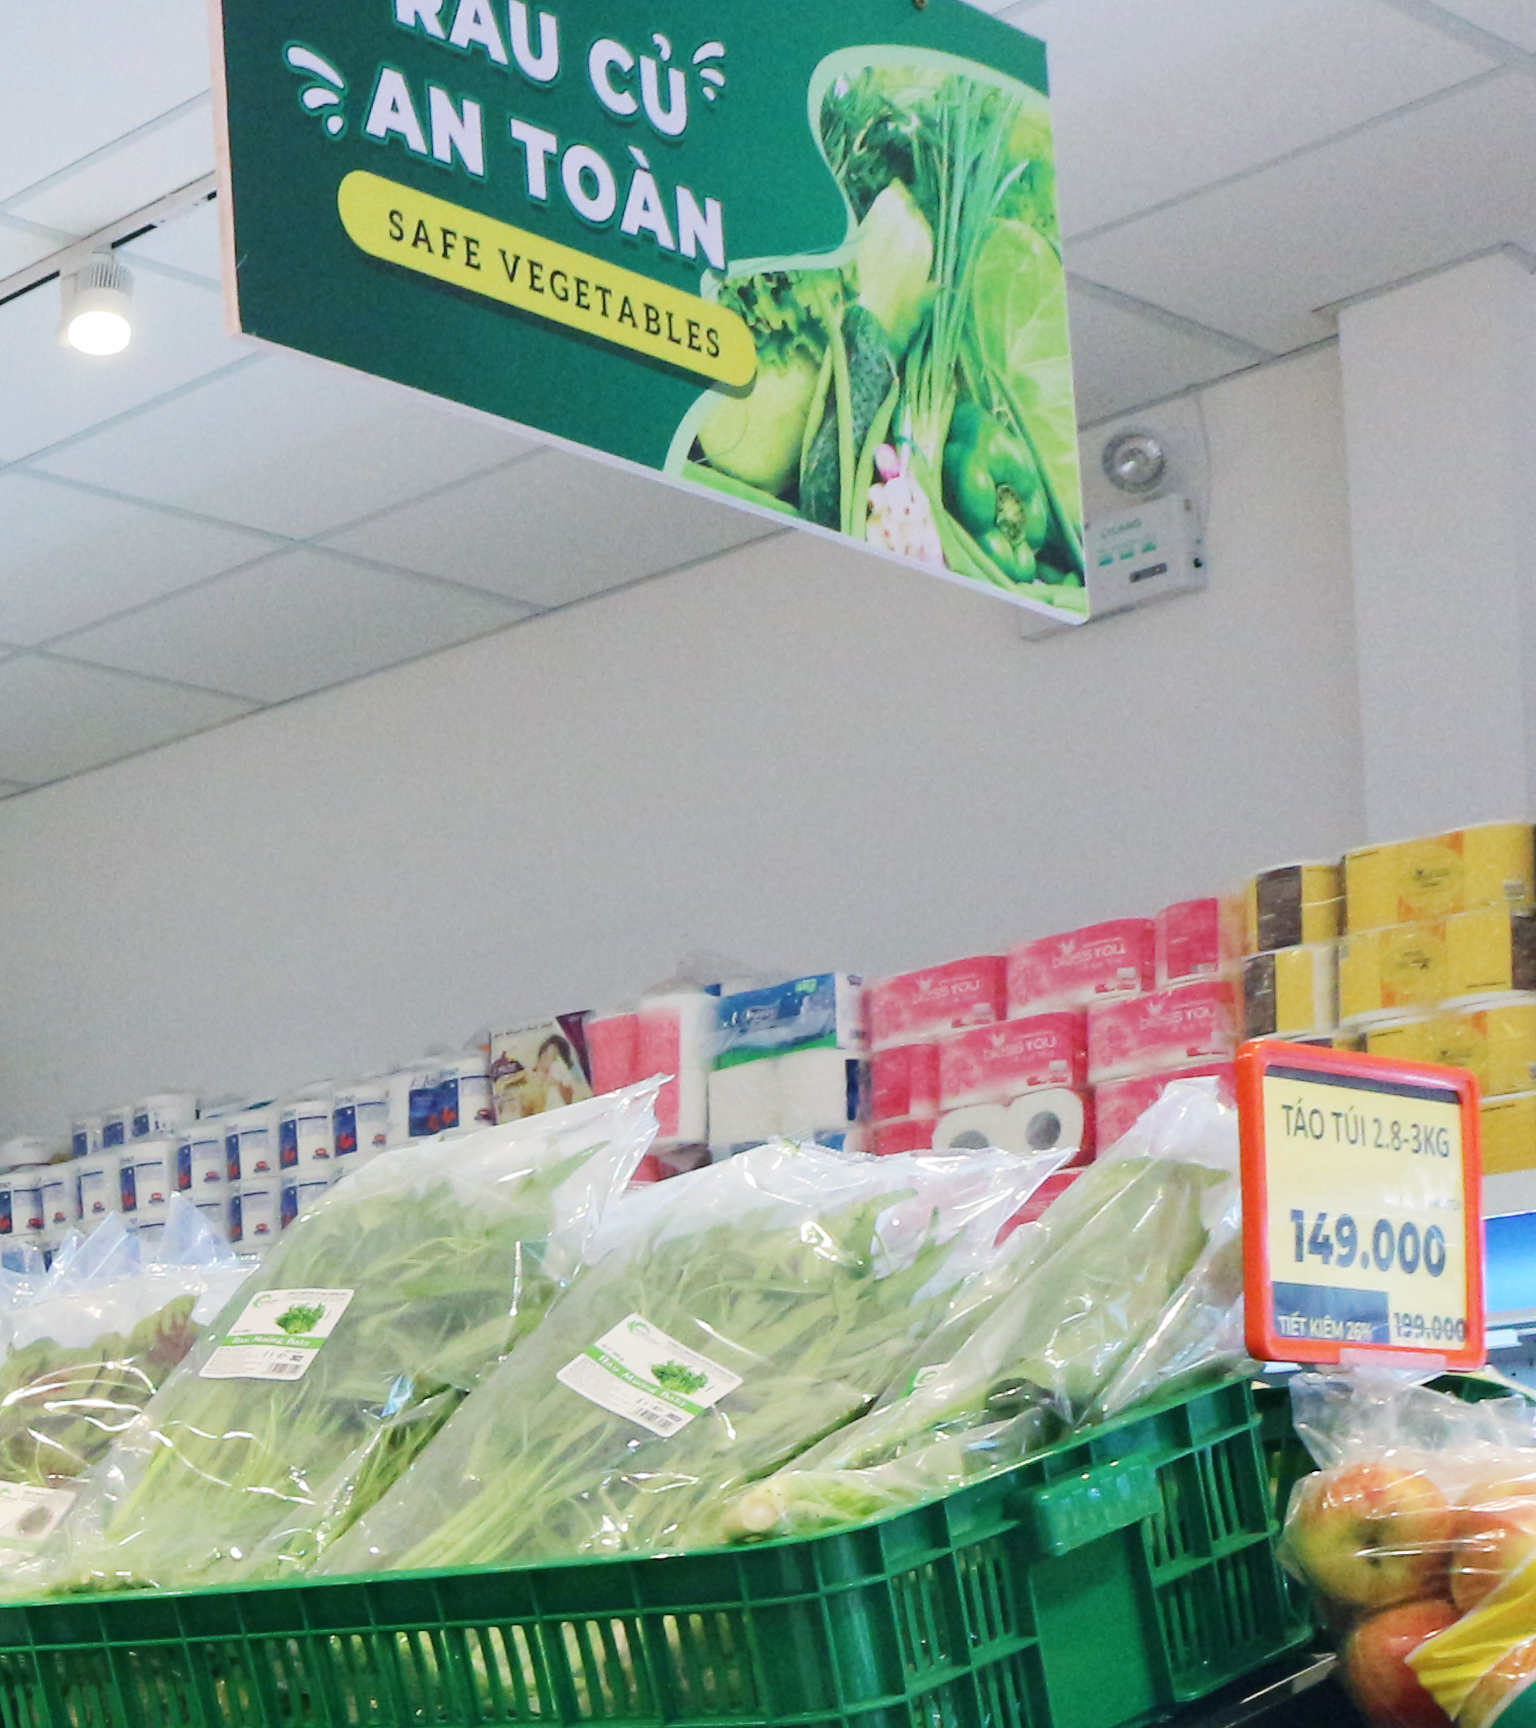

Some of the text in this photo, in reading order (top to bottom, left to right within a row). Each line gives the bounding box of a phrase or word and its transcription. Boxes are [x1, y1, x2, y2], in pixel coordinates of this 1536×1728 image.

[393, 0, 691, 140] RAU CỦ
[364, 69, 725, 273] AN TOÀN
[387, 206, 722, 361] SAFE VEGETABLES
[1282, 1098, 1450, 1158] TÁO TÚI 2.8-3KG
[1290, 1208, 1446, 1278] 149.000
